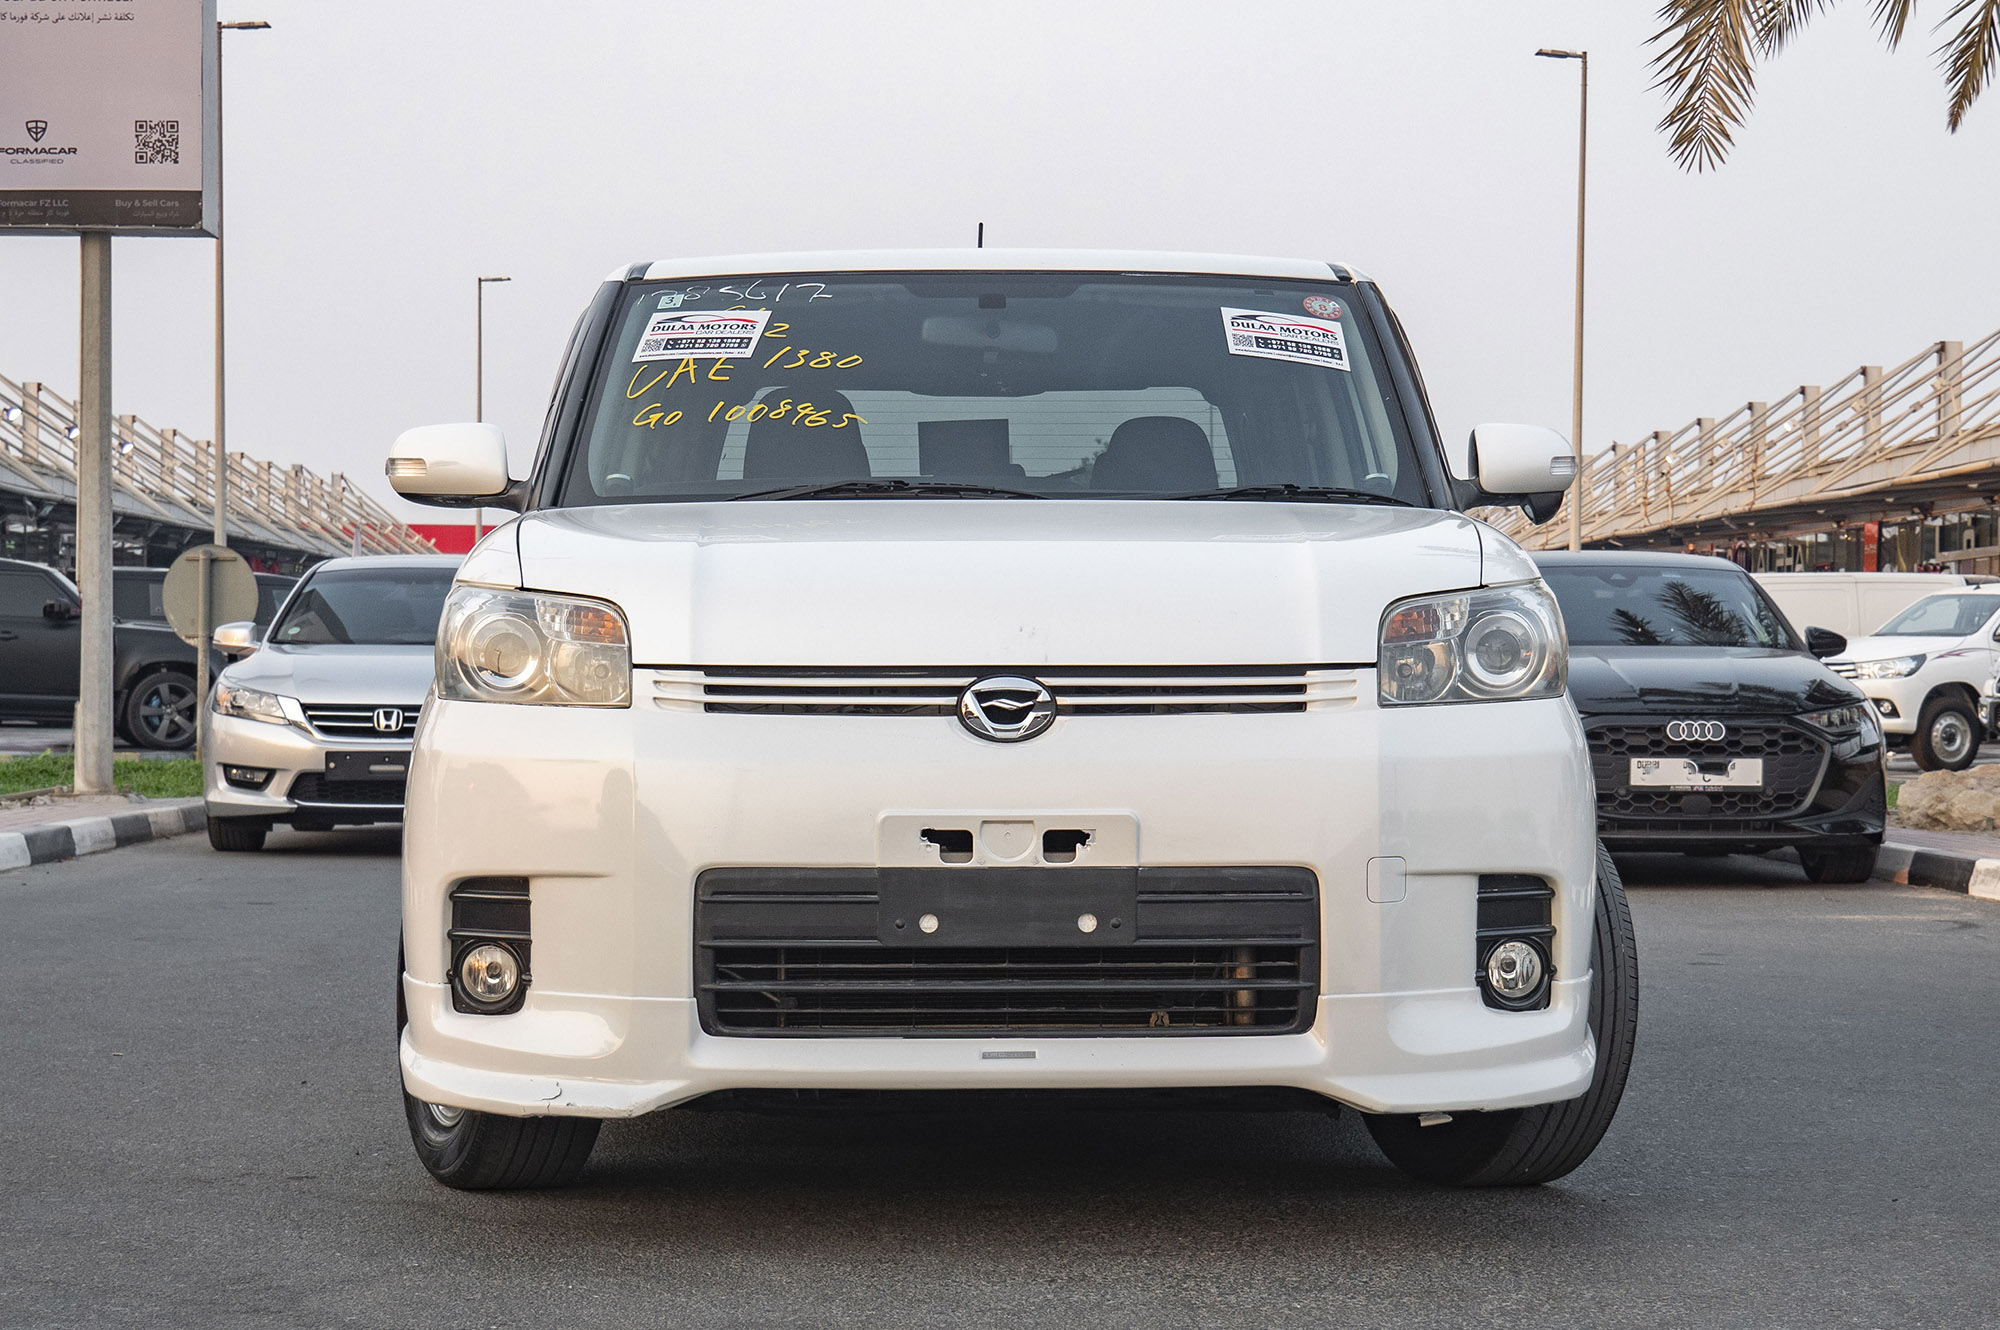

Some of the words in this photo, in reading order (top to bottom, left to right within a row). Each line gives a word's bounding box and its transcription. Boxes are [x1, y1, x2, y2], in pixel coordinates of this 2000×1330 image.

[31, 12, 49, 23] شركة
[52, 14, 65, 23] على
[97, 15, 112, 23] نشر
[115, 13, 134, 21] تكلفة
[115, 199, 132, 208] Buy
[142, 199, 157, 207] Sell
[160, 199, 179, 207] Cars
[651, 324, 694, 332] DULAA
[1231, 321, 1276, 332] DULAA
[1280, 327, 1338, 340] MOTORS
[1300, 335, 1339, 345] DEALERS
[764, 346, 864, 370] 1380
